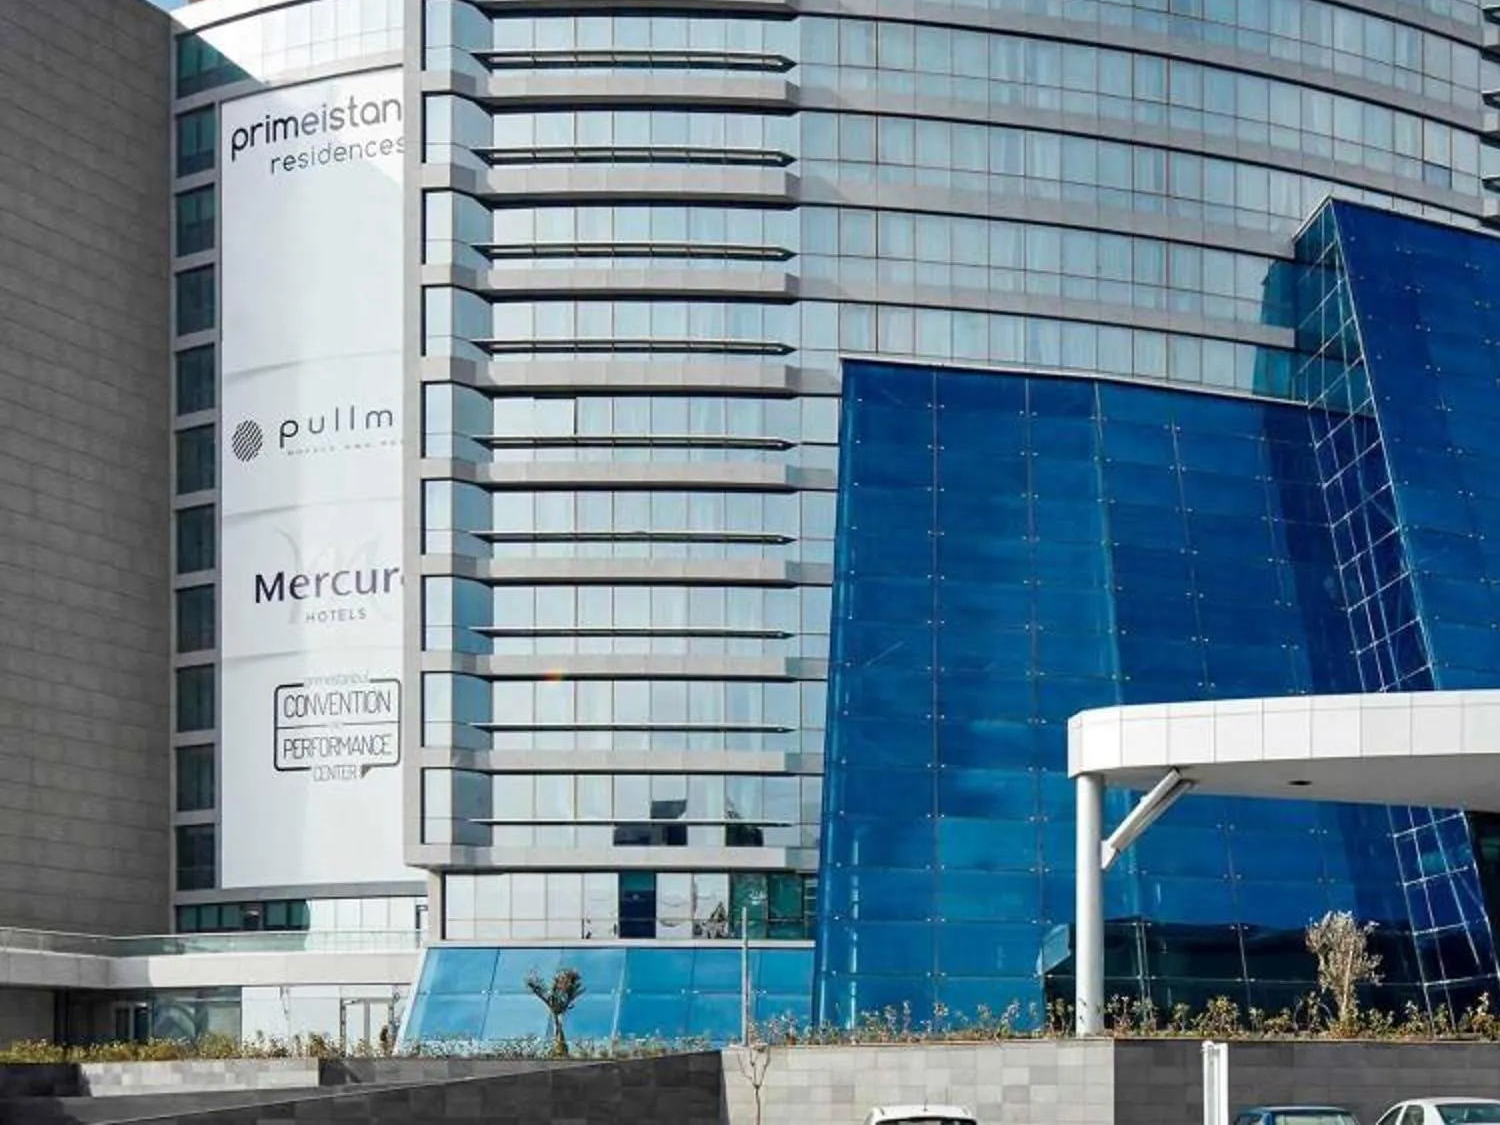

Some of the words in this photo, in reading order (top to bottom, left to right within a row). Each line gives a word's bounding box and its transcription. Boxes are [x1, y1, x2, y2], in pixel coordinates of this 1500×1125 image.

[270, 136, 406, 174] residences
[255, 567, 404, 604] Mercur
[306, 608, 367, 623] HOTELS
[283, 690, 391, 718] CONVENTION
[283, 734, 393, 760] PERFORMANCE
[313, 766, 357, 782] CENTER
